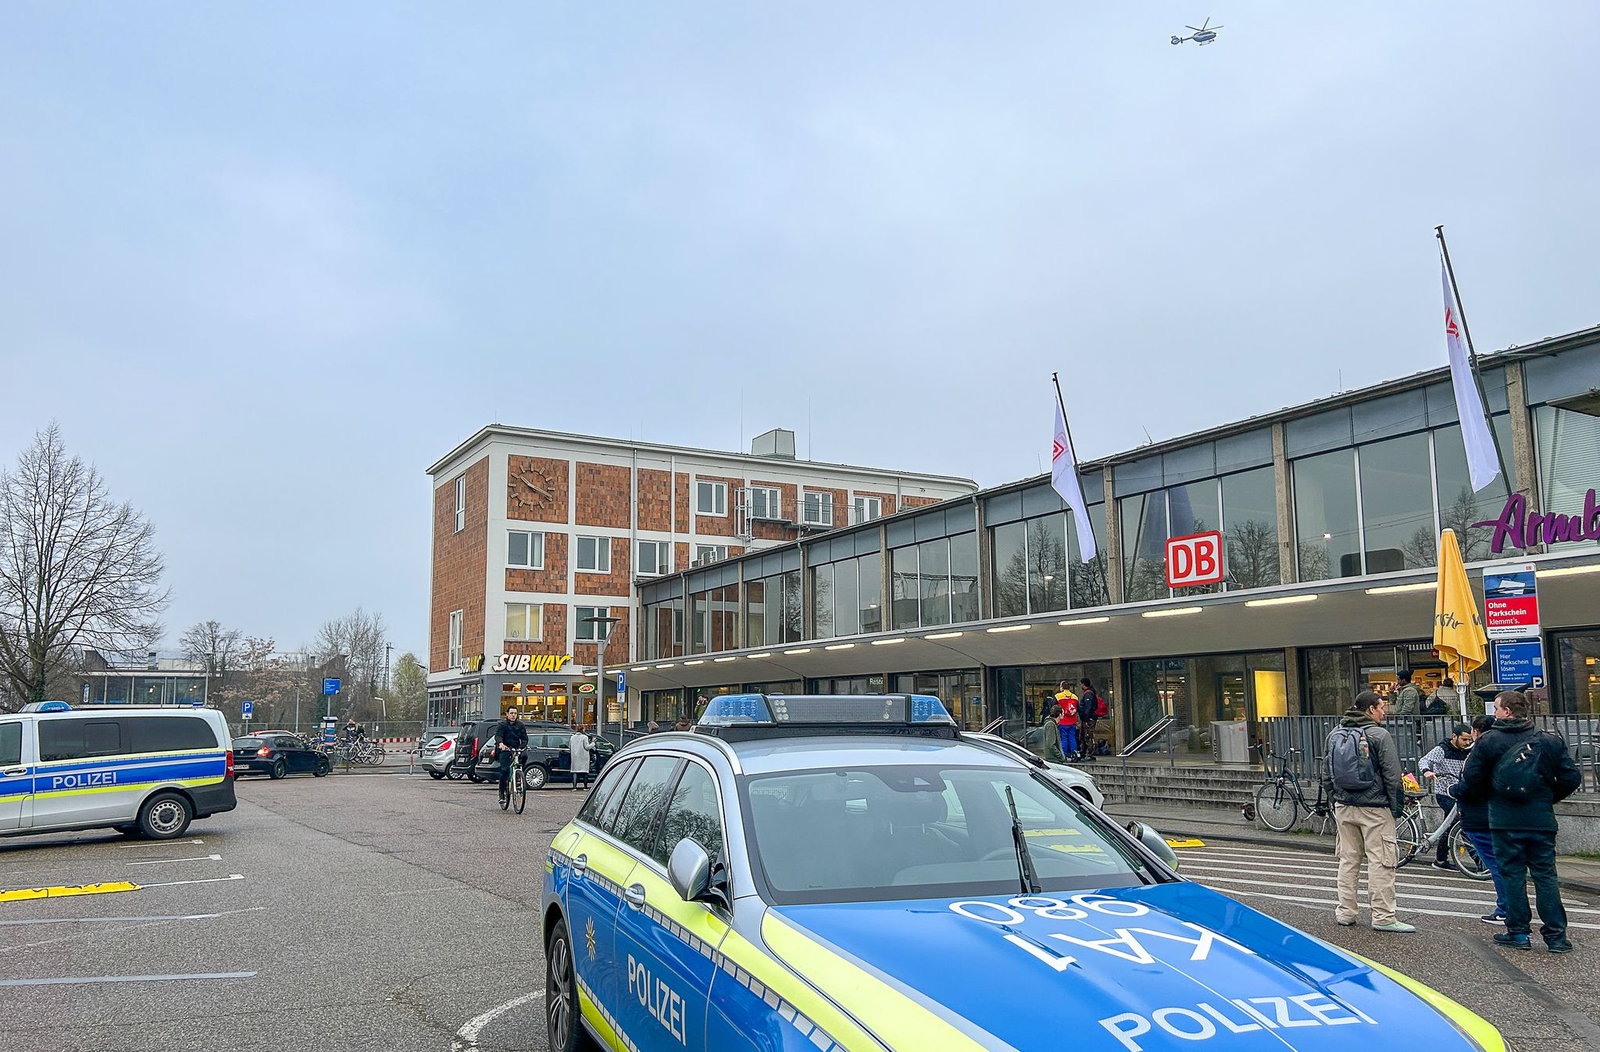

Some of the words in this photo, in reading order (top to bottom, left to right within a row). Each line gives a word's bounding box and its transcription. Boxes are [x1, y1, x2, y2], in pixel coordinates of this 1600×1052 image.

[1469, 489, 1600, 553] Armb
[1172, 540, 1216, 579] DB
[493, 653, 572, 672] SUBWAY
[619, 674, 624, 690] P
[1533, 677, 1542, 688] P
[244, 703, 250, 711] P
[52, 772, 117, 788] POLIZEI
[627, 953, 687, 1046] POLIZEI
[1098, 992, 1379, 1052] POLIZEI
